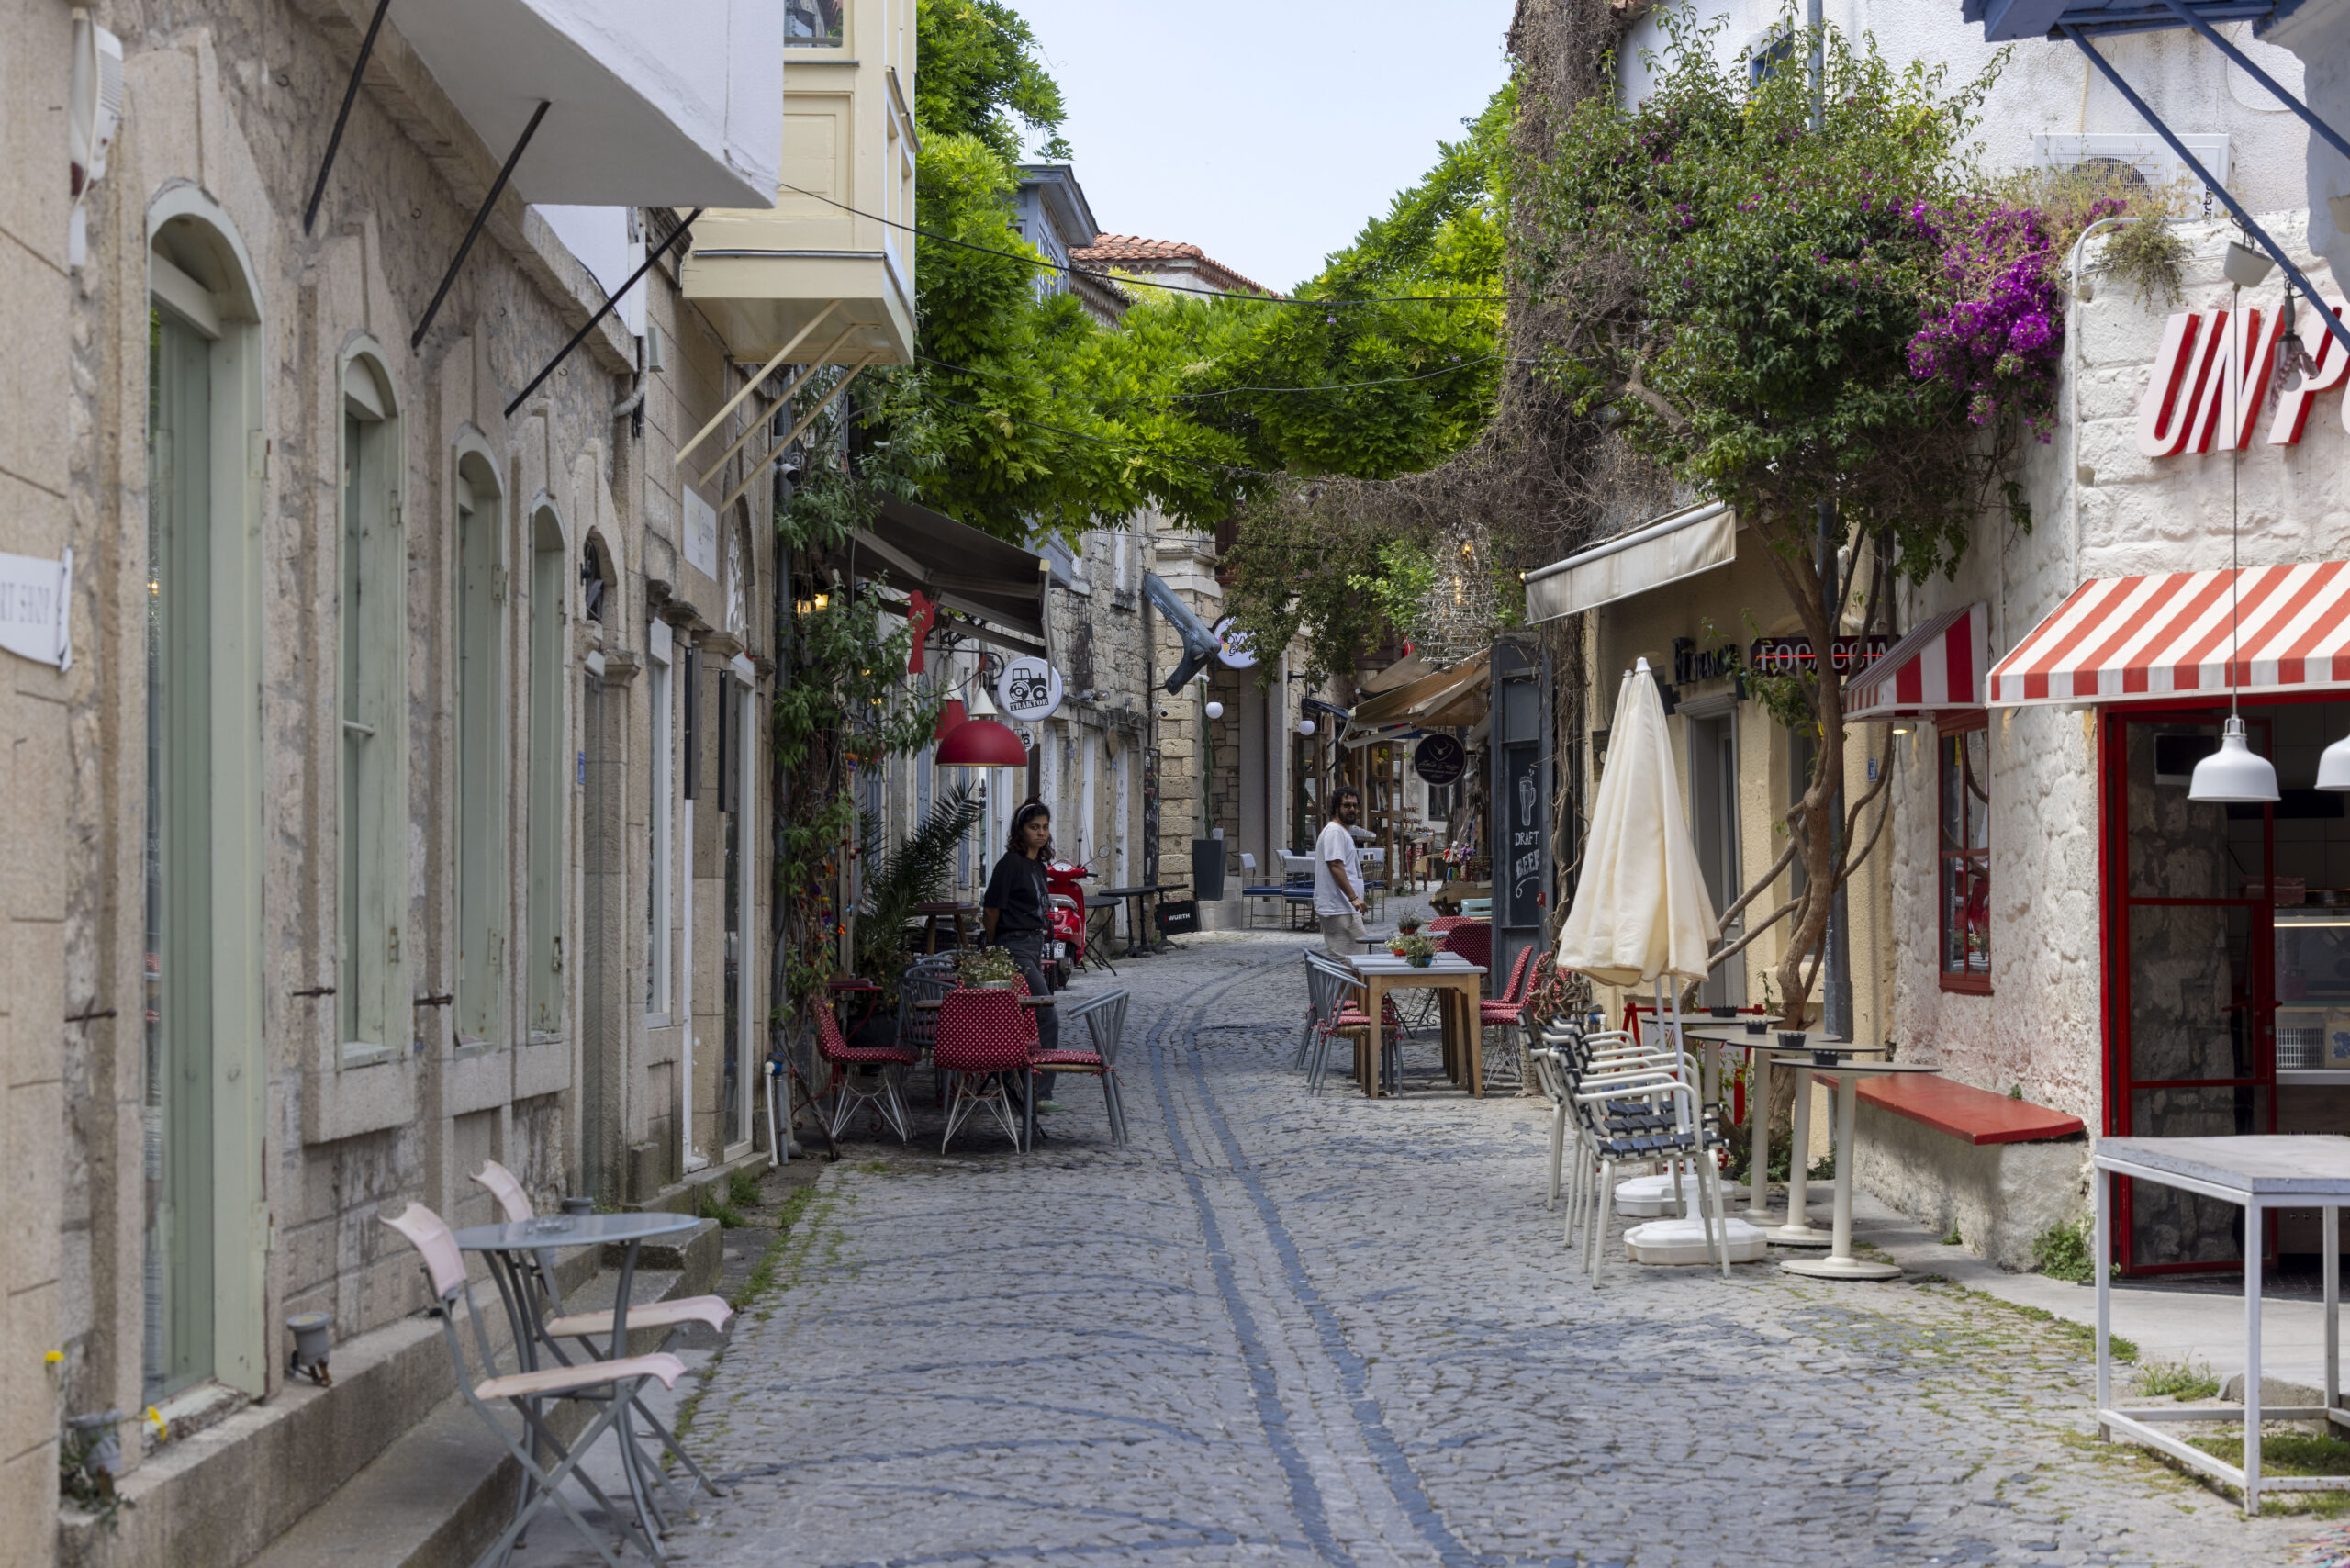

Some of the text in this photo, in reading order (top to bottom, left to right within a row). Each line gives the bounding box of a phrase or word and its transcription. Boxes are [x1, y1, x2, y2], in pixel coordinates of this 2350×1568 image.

[2135, 297, 2350, 457] UNP
[1761, 643, 1887, 671] FOCCCIA
[1010, 698, 1049, 711] TRAKTOR
[1515, 831, 1539, 846] DRAFT
